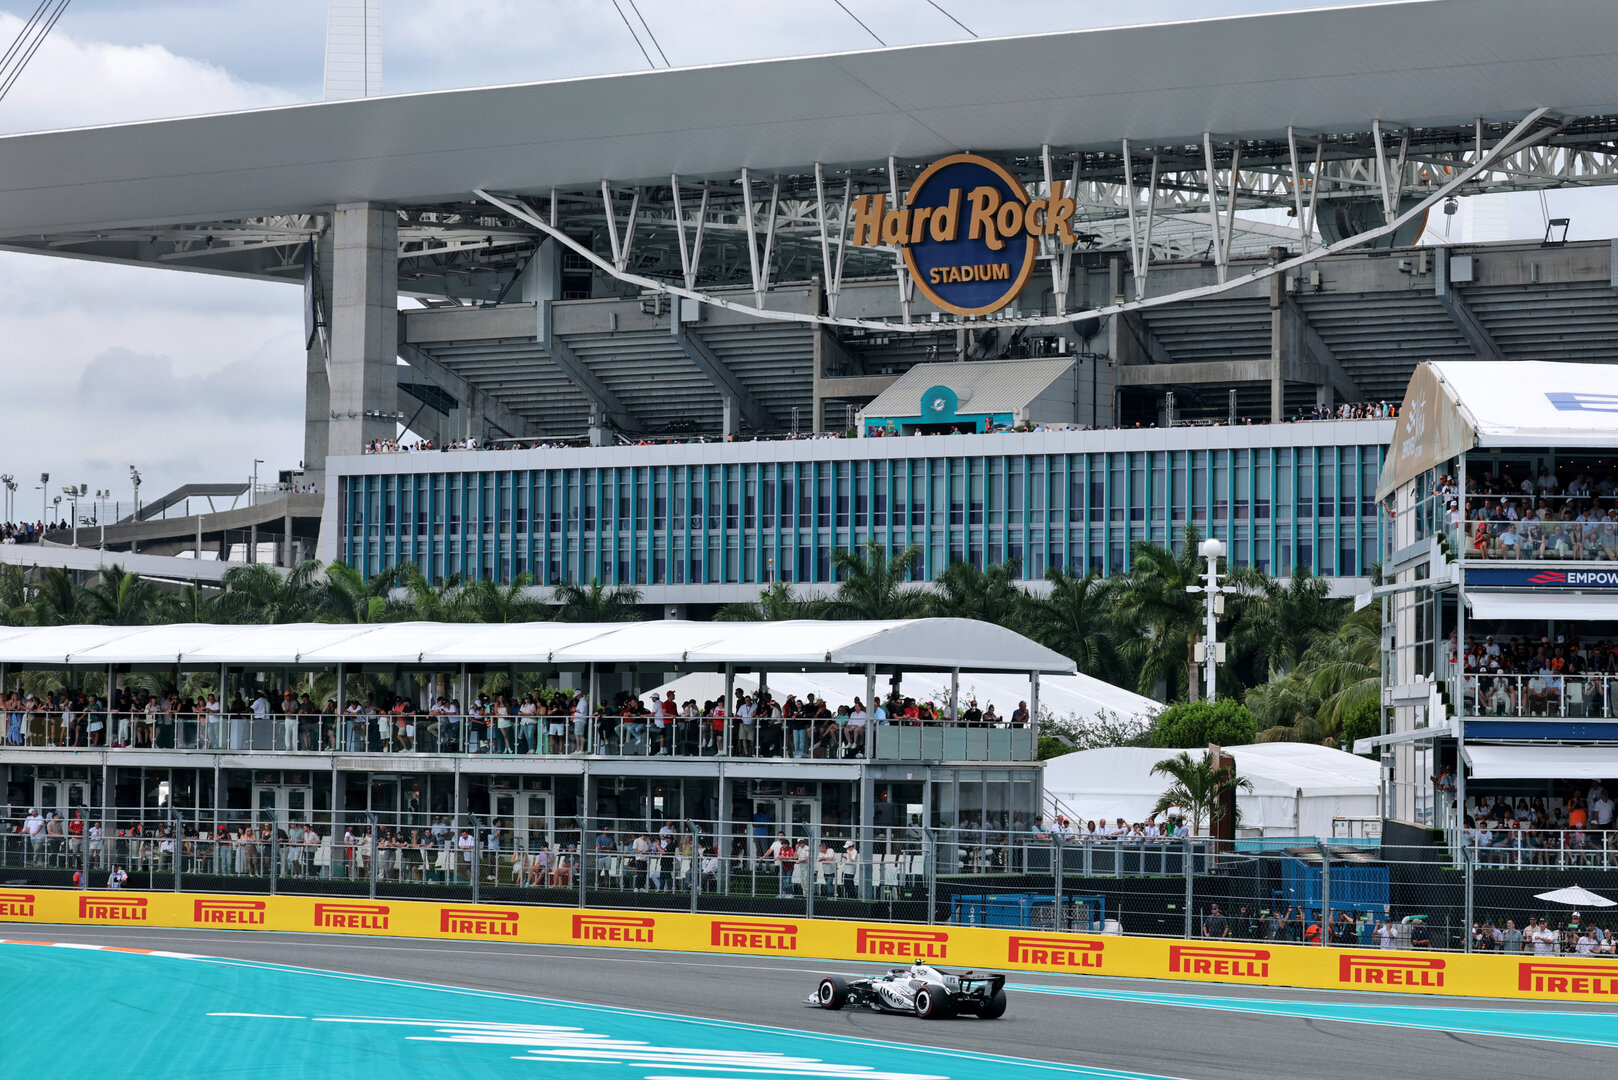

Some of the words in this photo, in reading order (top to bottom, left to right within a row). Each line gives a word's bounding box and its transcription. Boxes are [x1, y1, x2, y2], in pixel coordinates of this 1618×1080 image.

[851, 188, 963, 247] Hard
[967, 180, 1078, 250] Rock
[929, 263, 1011, 285] STADIUM
[0, 893, 36, 917] ELLI
[78, 896, 148, 921] PIRELLI
[193, 899, 266, 925] PIRELLI
[314, 903, 390, 930] PIRELLI
[440, 908, 520, 936] PIRELLI
[572, 914, 656, 943] PIRELLI
[711, 921, 798, 951] PIRELLI
[857, 928, 949, 959] PIRELLI
[1008, 936, 1105, 968] PIRELLI
[1169, 945, 1271, 978] PIRELLI
[1339, 954, 1447, 987] PIRELLI
